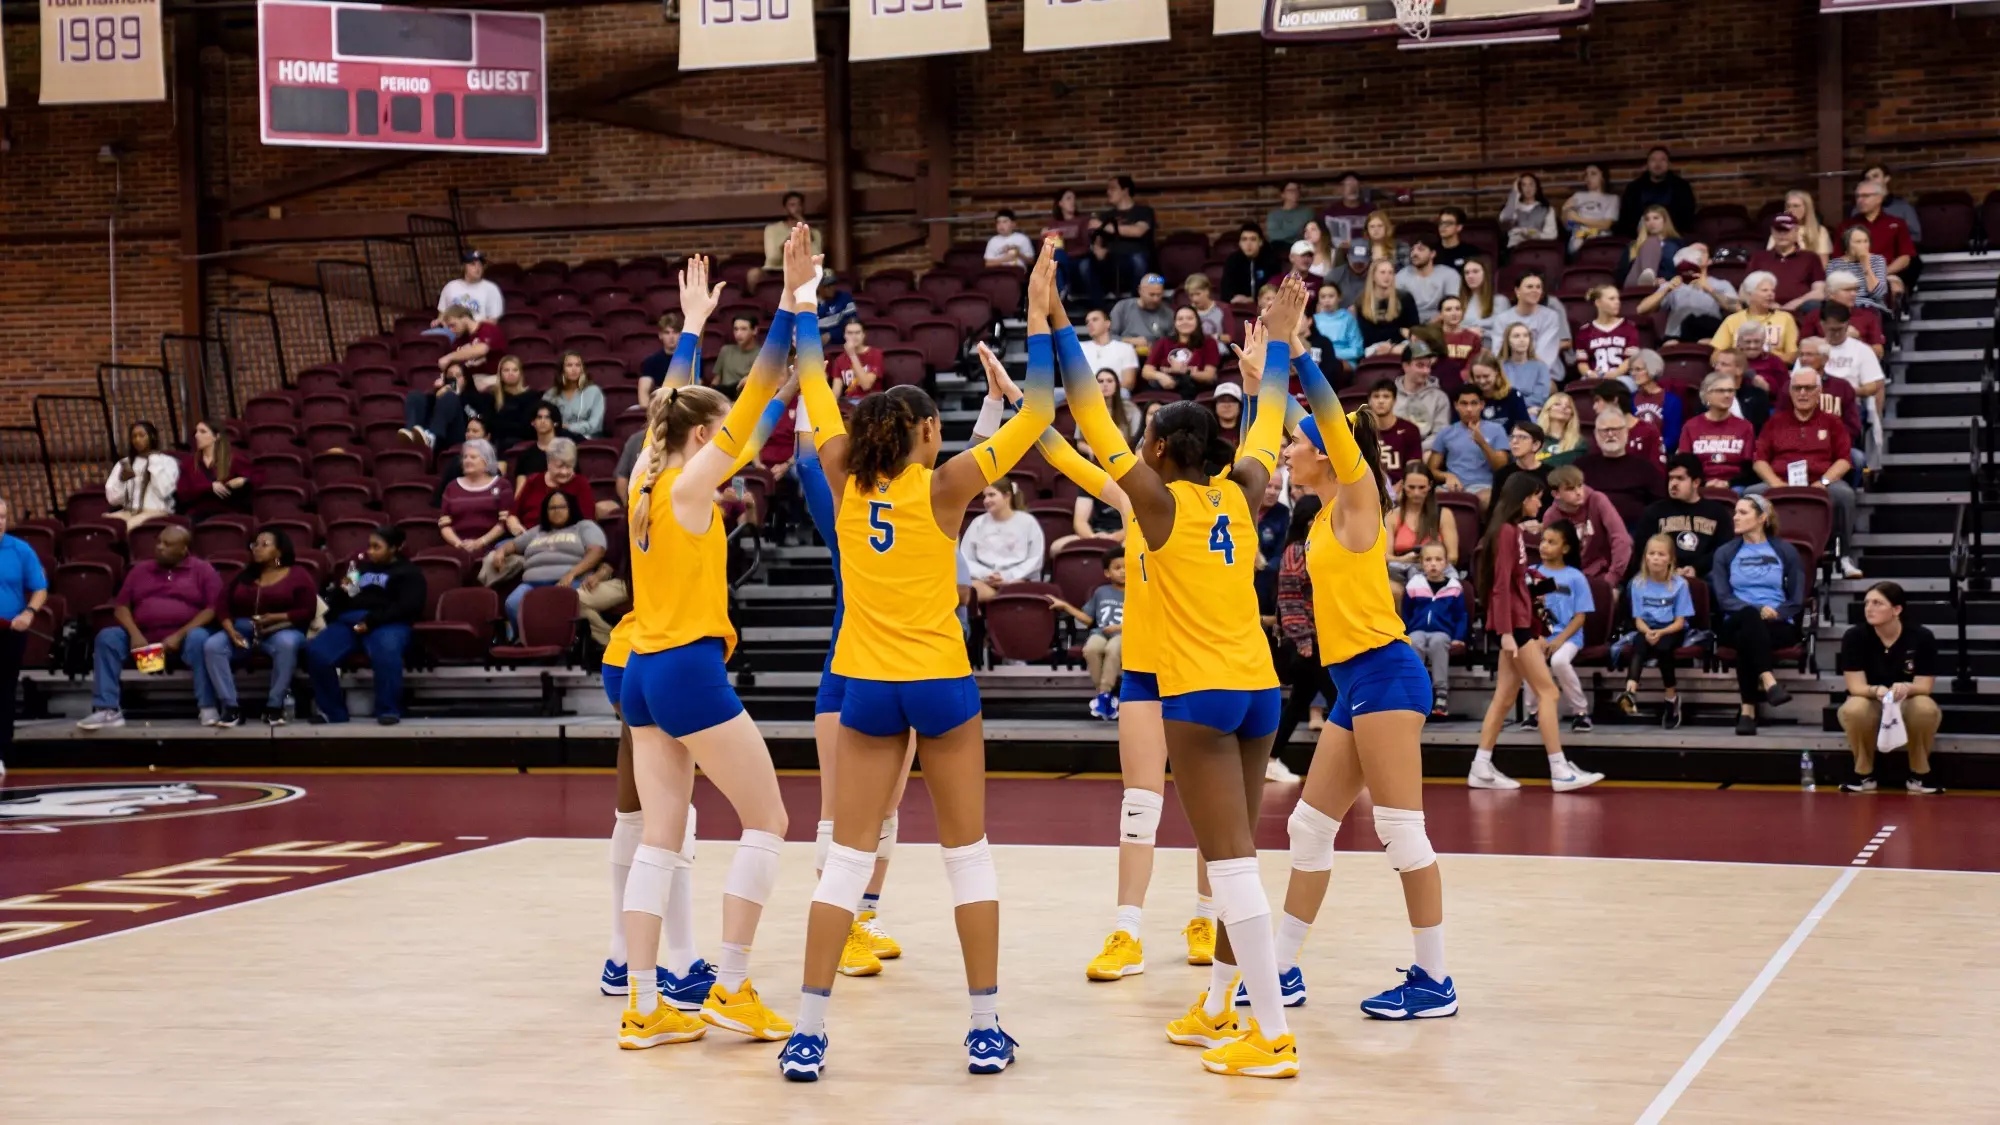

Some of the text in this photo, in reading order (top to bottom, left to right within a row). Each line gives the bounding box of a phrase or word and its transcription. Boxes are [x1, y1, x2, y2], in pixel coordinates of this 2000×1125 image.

[1280, 7, 1360, 27] NO DUNKING
[59, 16, 141, 62] 1989
[278, 60, 339, 84] HOME
[380, 76, 431, 93] PERIOD
[467, 69, 530, 91] GUEST
[1378, 440, 1400, 469] SU
[868, 500, 895, 554] 5
[1208, 513, 1235, 565] 4
